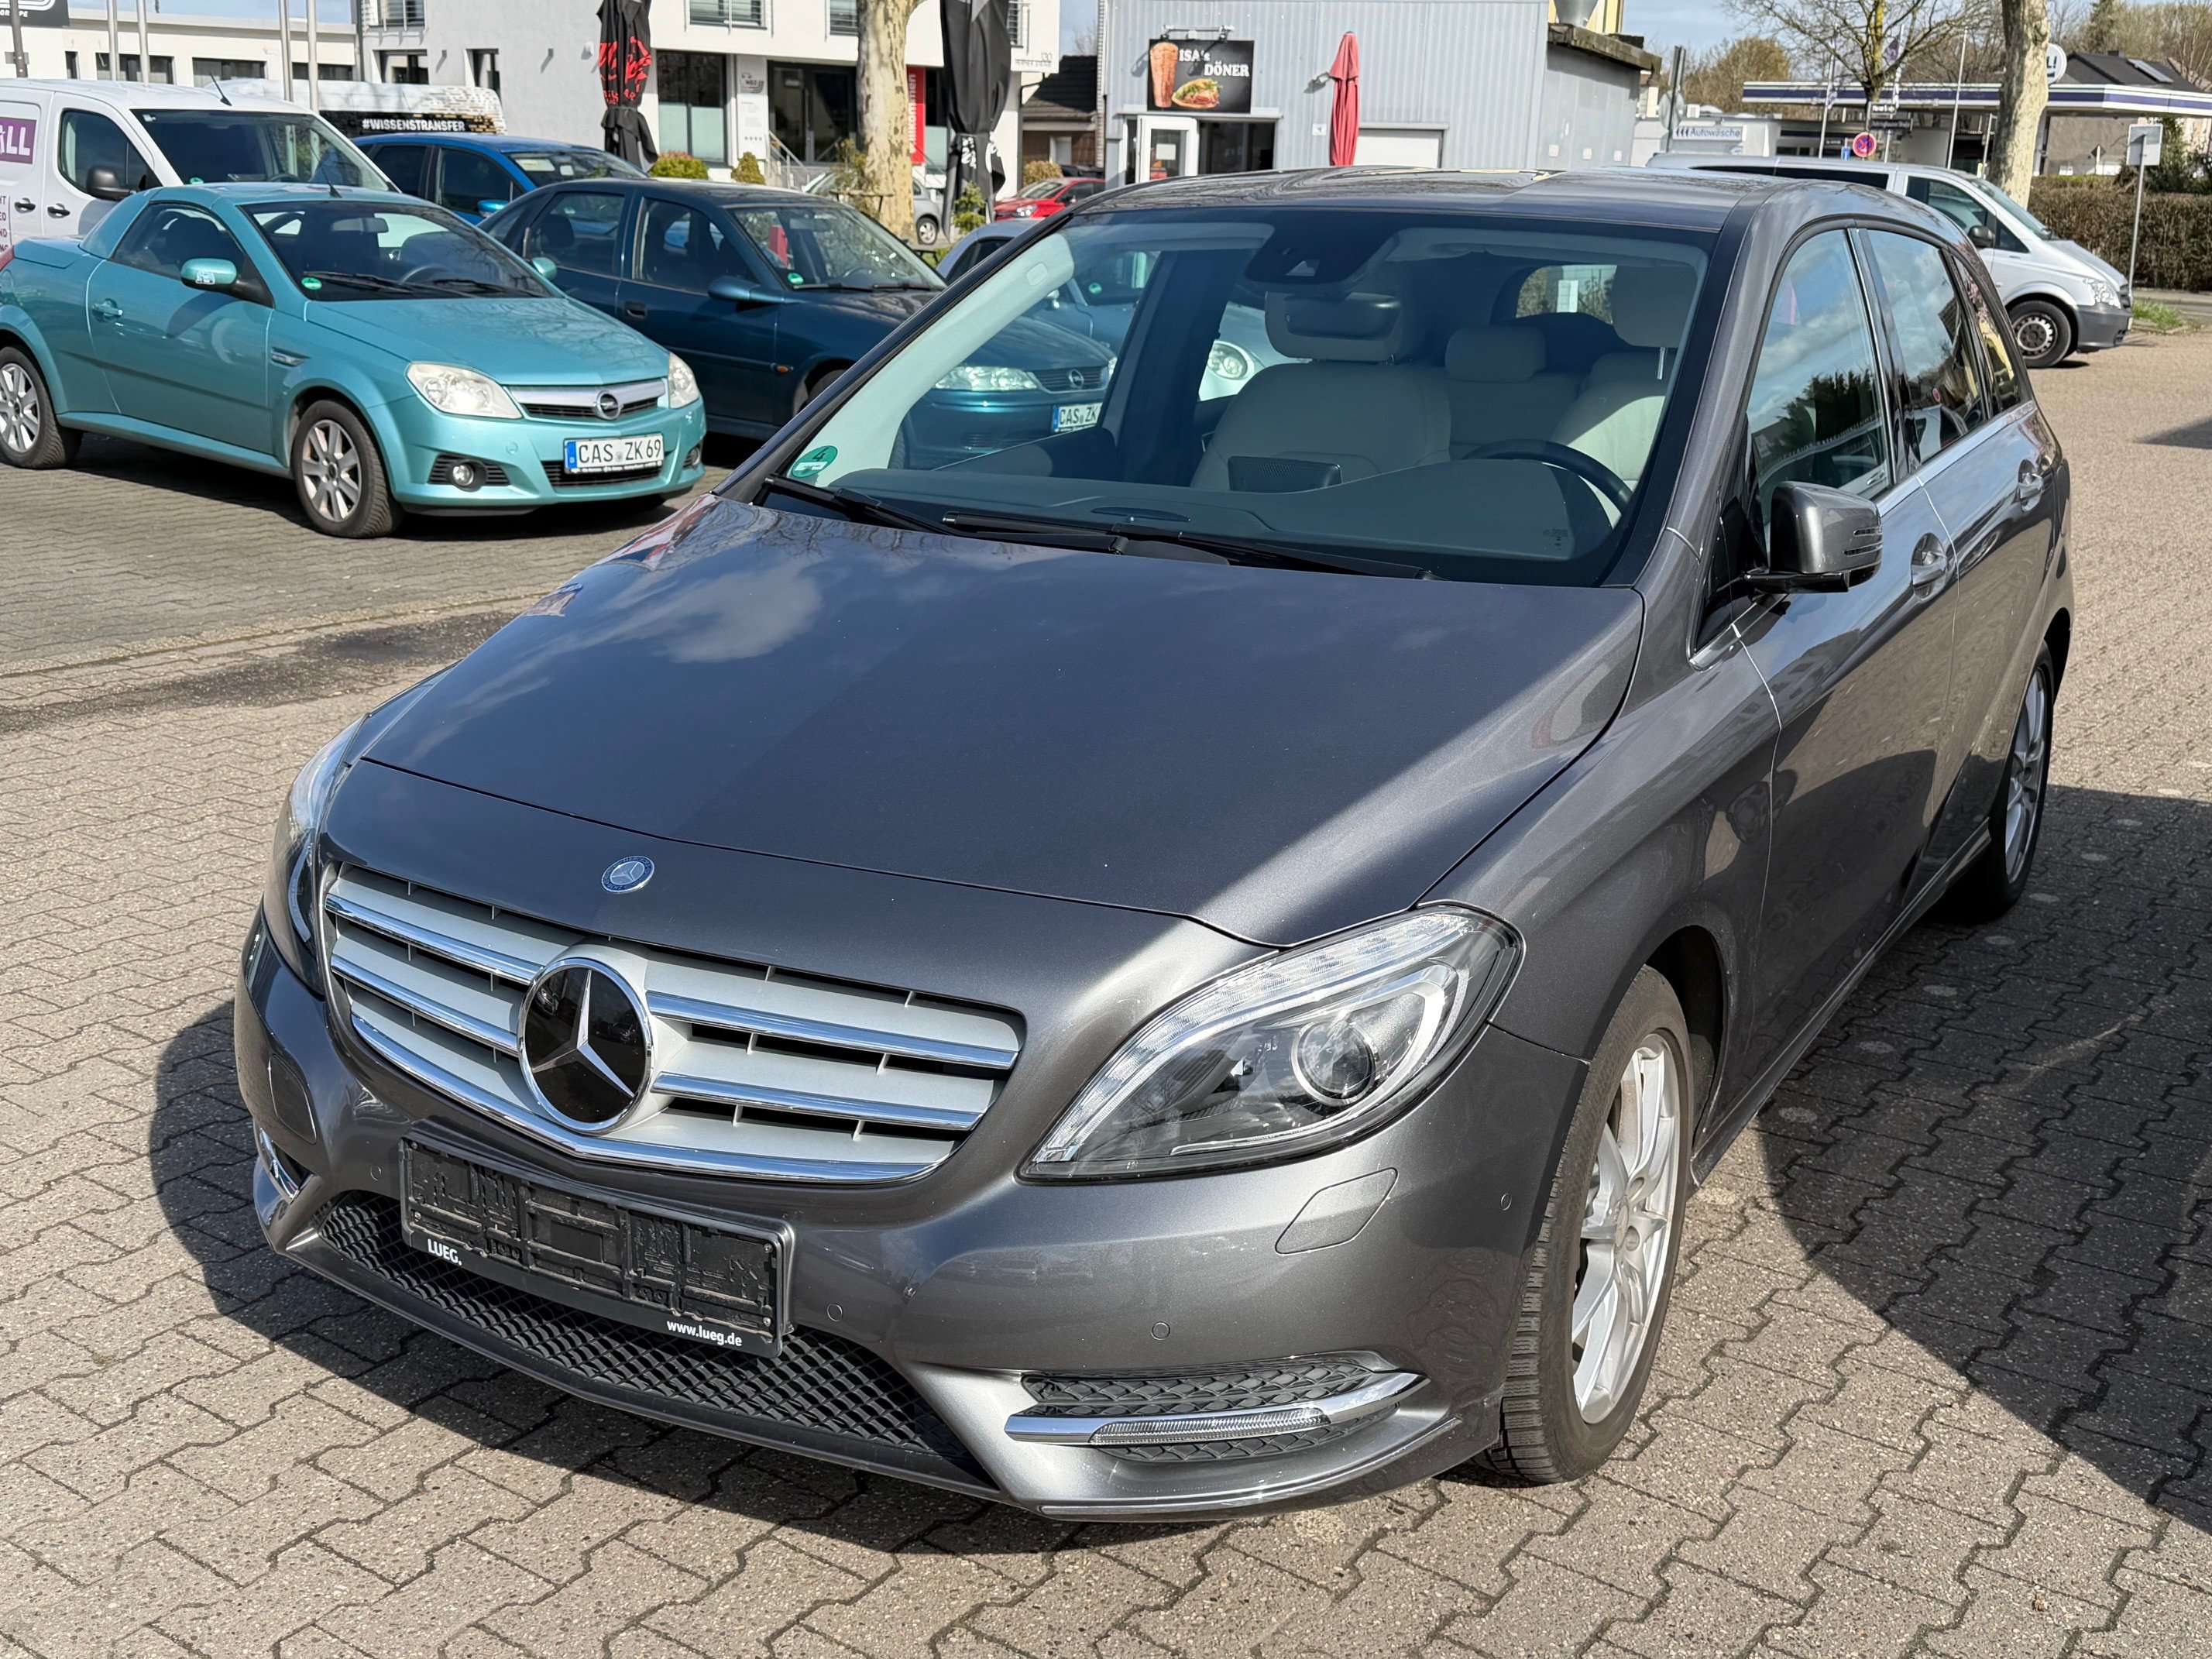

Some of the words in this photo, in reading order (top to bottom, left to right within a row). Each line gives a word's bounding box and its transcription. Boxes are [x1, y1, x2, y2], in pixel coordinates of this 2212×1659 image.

[1204, 60, 1249, 77] DÖNER
[362, 118, 465, 132] #WISSENSTRANSFER
[1060, 408, 1080, 425] CAS
[1085, 406, 1098, 422] ZK
[579, 444, 613, 463] CAS
[624, 441, 643, 461] ZK
[646, 439, 661, 459] 69
[812, 447, 830, 462] 4
[428, 1238, 462, 1266] LUEG.
[667, 1321, 743, 1346] www.lueg.de
